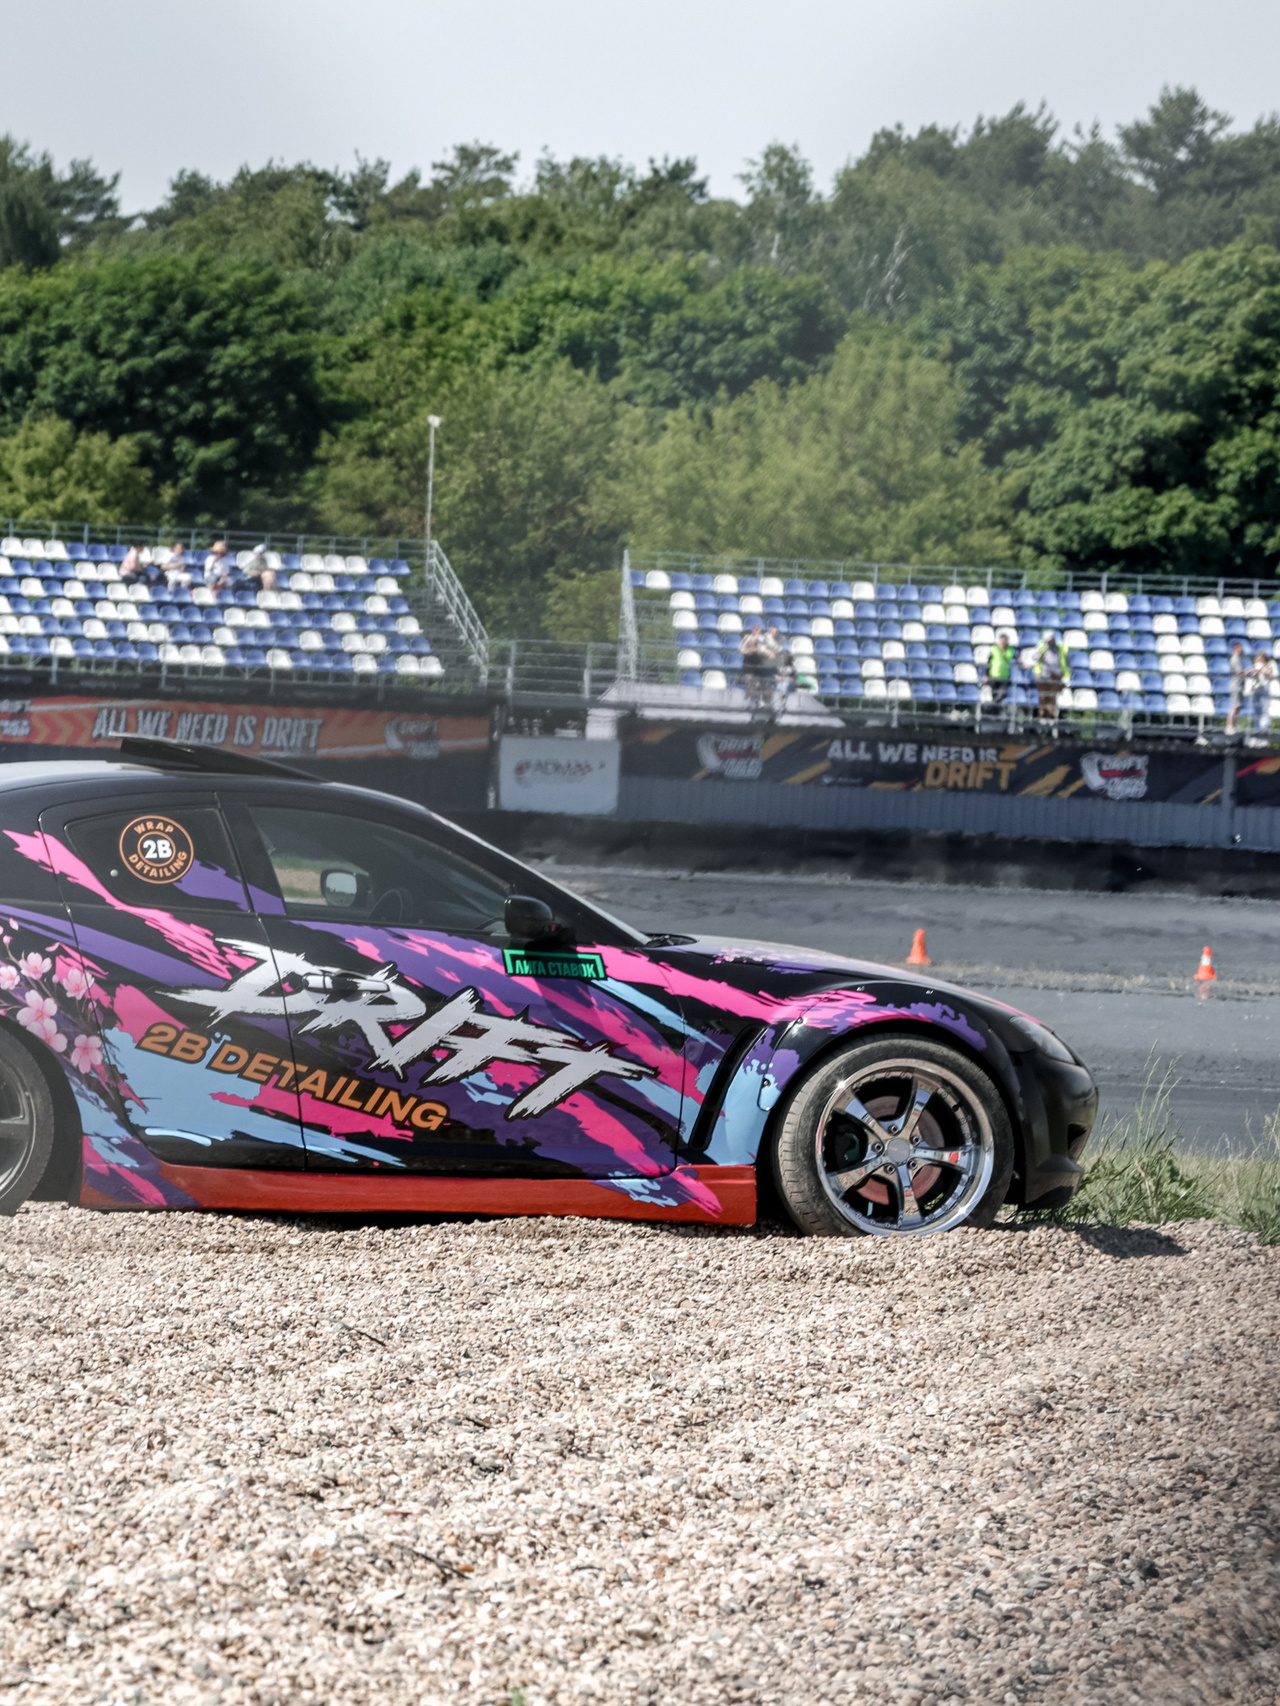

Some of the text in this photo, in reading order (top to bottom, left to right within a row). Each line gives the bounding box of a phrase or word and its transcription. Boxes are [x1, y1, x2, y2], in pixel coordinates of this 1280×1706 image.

[92, 707, 322, 748] ALL WE NEED IS DRIFT
[827, 739, 998, 764] ALL WE NEED IS
[924, 760, 1017, 791] DRIFT
[133, 821, 175, 834] WRAP
[142, 839, 173, 859] 2B
[128, 851, 188, 878] DETAILING
[515, 959, 597, 978] ЛИГА СТАВОК
[155, 937, 659, 1120] DRIFT
[138, 1023, 450, 1131] 2B DETAILING
